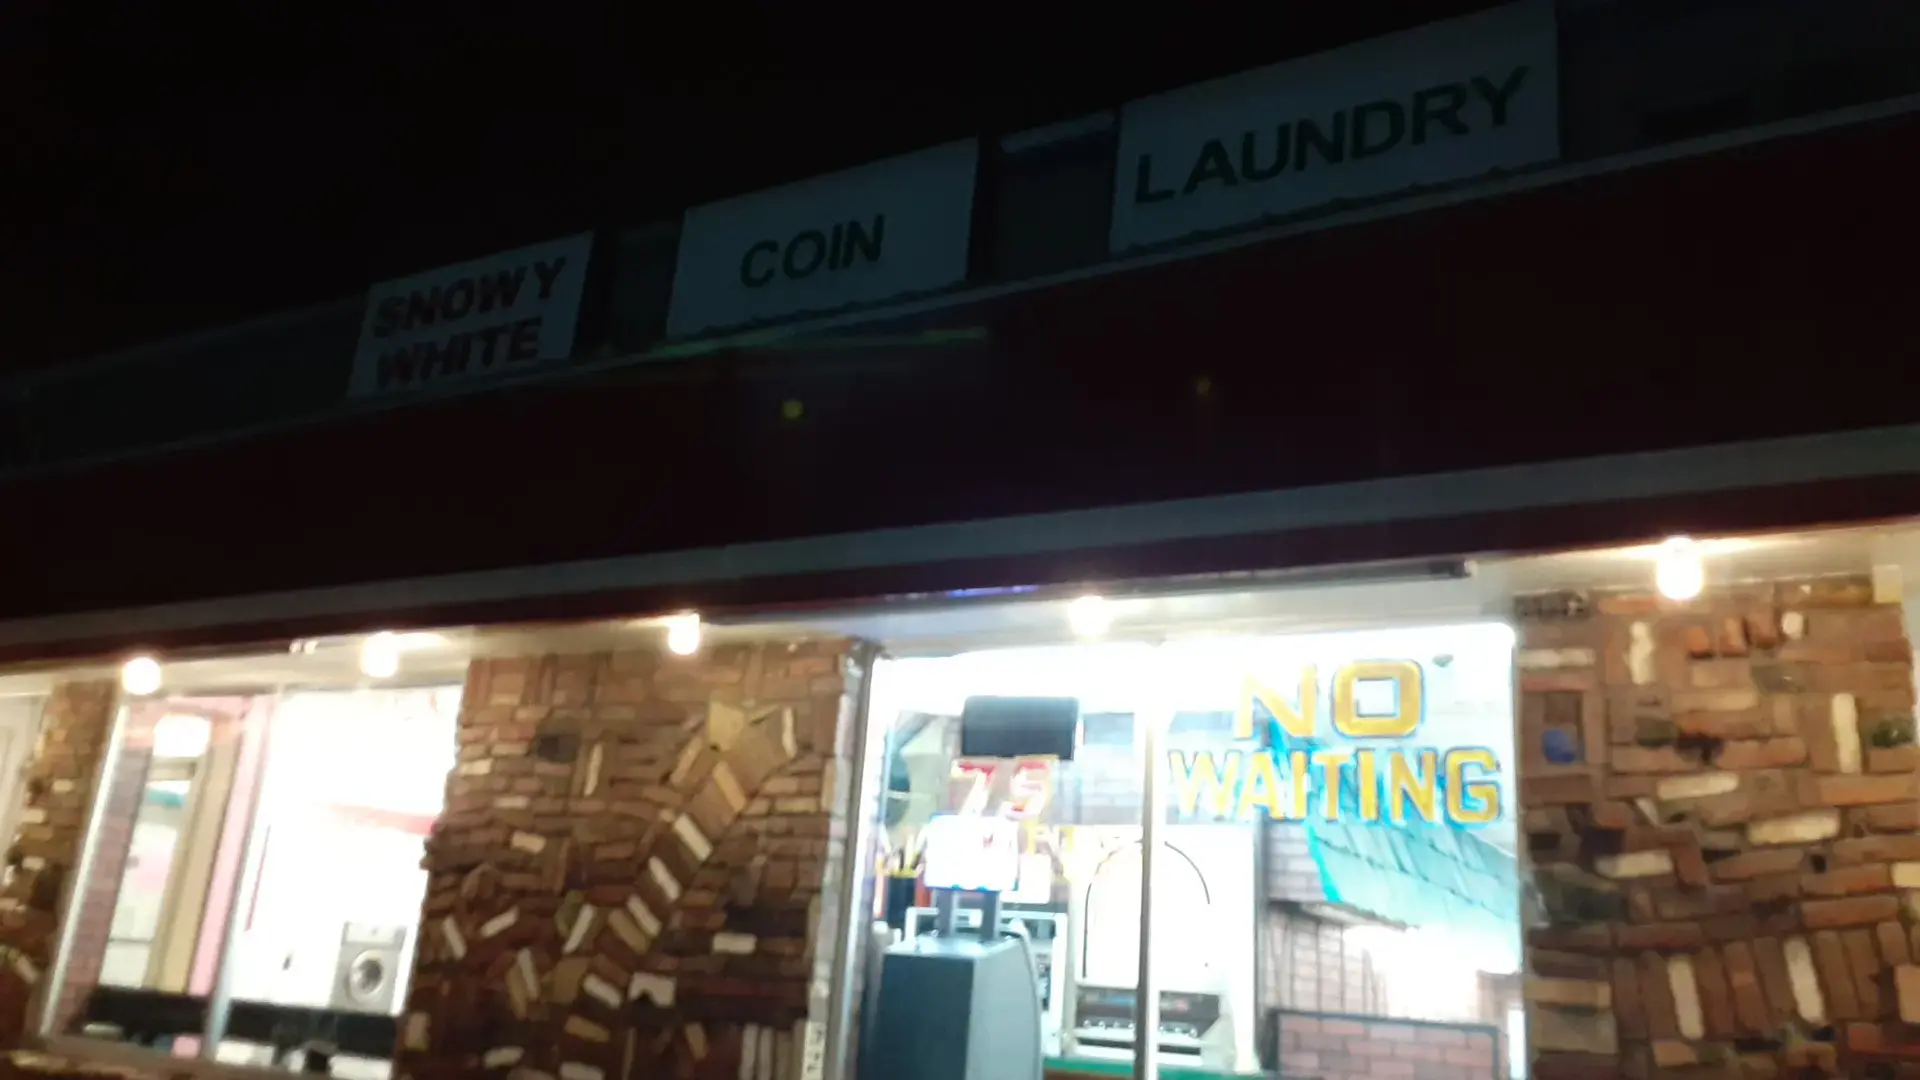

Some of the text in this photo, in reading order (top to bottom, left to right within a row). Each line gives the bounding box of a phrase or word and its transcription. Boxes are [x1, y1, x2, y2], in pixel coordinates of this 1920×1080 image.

[1136, 65, 1530, 203] LAUNDRY
[740, 214, 884, 288] COIN
[372, 256, 566, 338] SNOWY
[376, 317, 542, 390] WHITE
[1234, 659, 1426, 740] NO
[1167, 746, 1502, 824] WAITING
